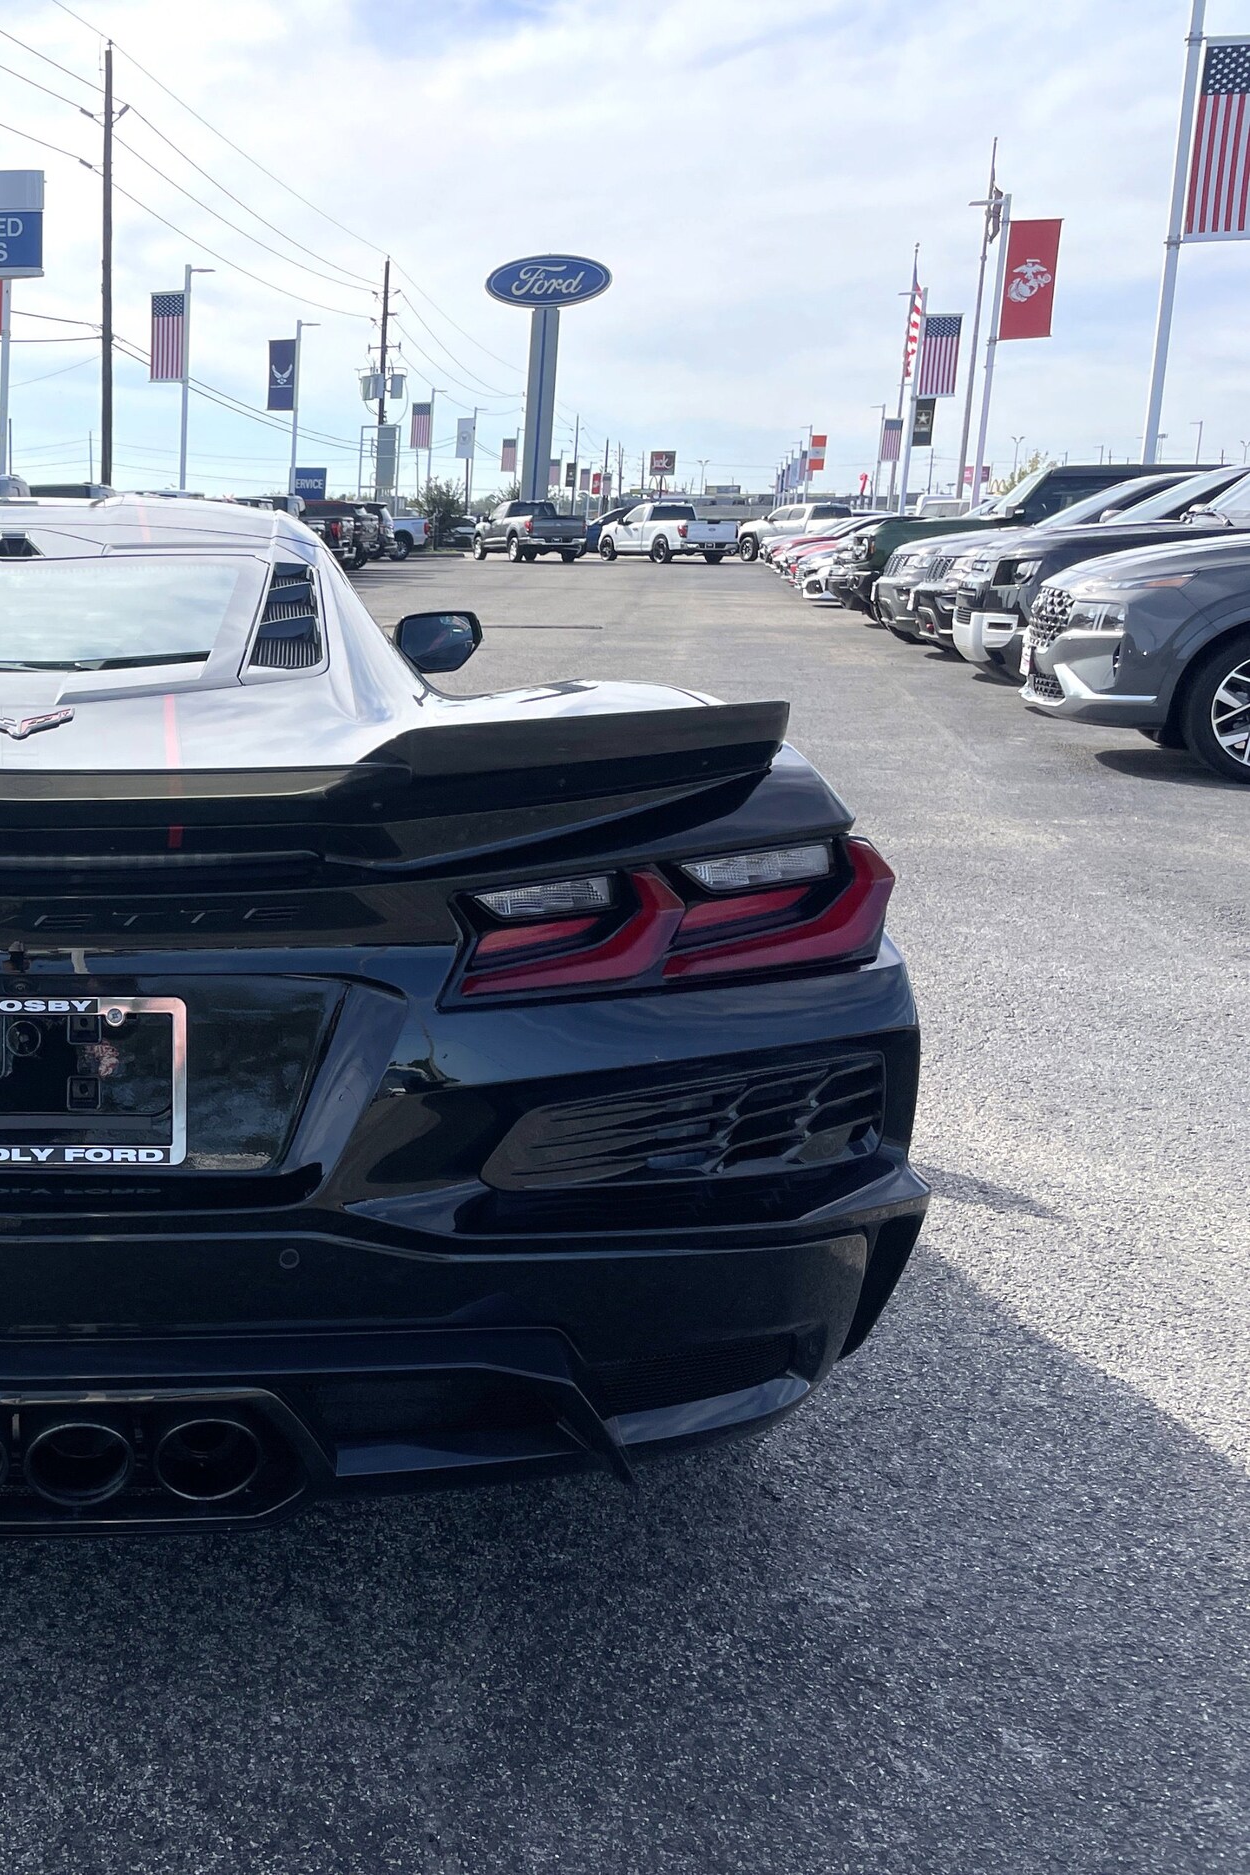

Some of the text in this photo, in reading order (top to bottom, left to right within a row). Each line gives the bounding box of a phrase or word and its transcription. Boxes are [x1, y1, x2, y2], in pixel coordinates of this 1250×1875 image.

[511, 265, 585, 295] Ford
[295, 478, 324, 489] ERVICE
[64, 1148, 164, 1162] FORD
